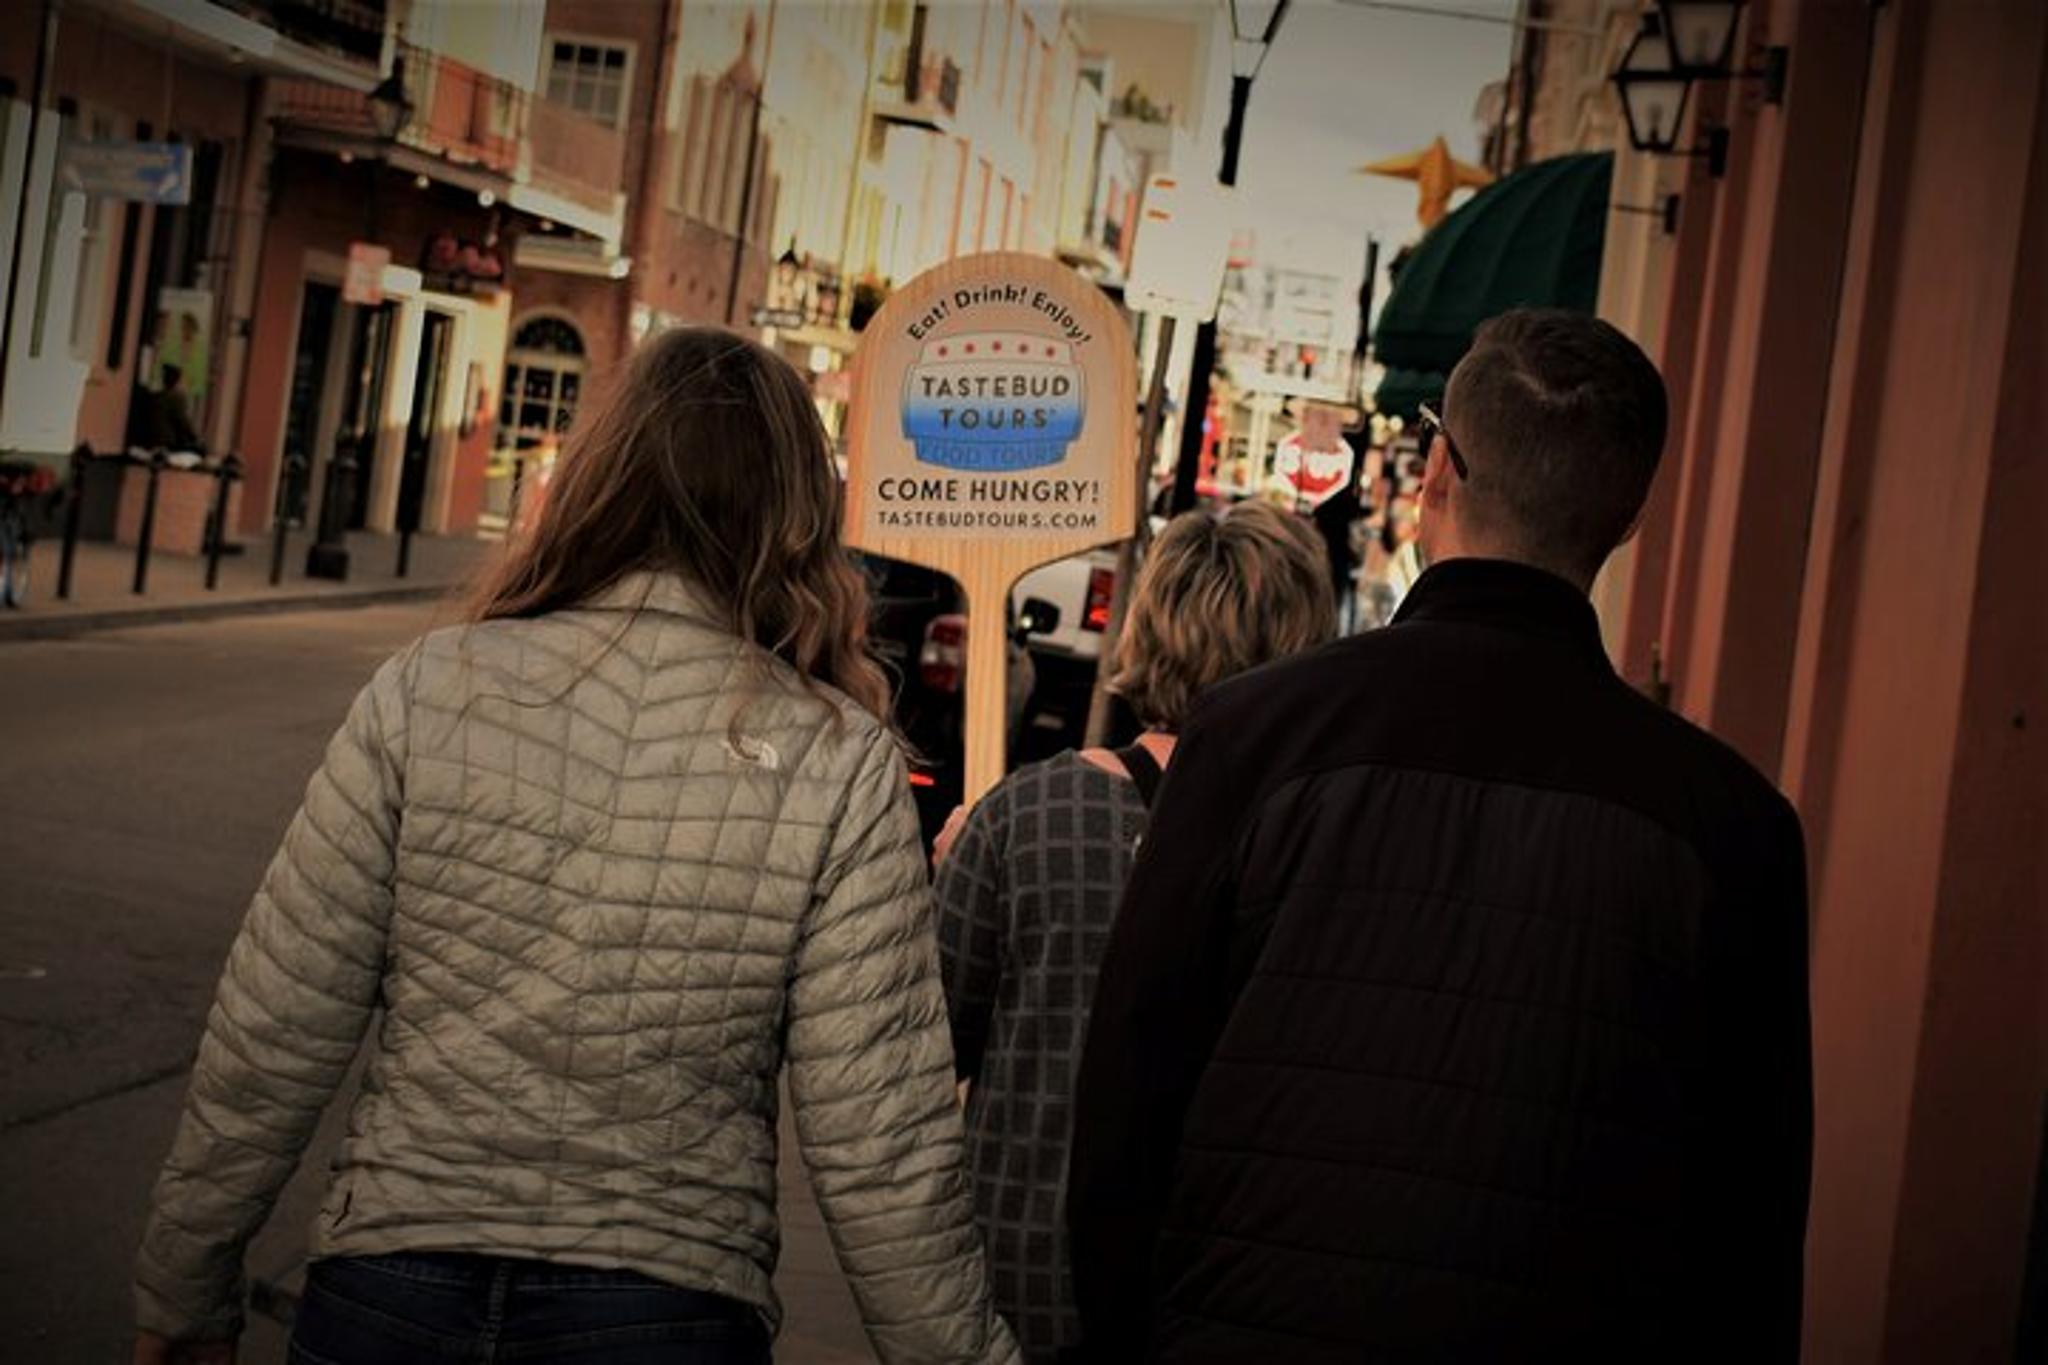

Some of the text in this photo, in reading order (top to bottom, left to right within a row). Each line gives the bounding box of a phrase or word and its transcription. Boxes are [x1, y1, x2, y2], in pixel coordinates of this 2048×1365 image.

[906, 284, 1092, 344] Eat! Drink! Enjoy!
[921, 375, 1071, 398] TASTEBUD
[939, 409, 1048, 429] TOURS
[878, 478, 1100, 502] COME HUNGRY!
[878, 510, 1097, 528] TASTEBUDTOURS.COM
